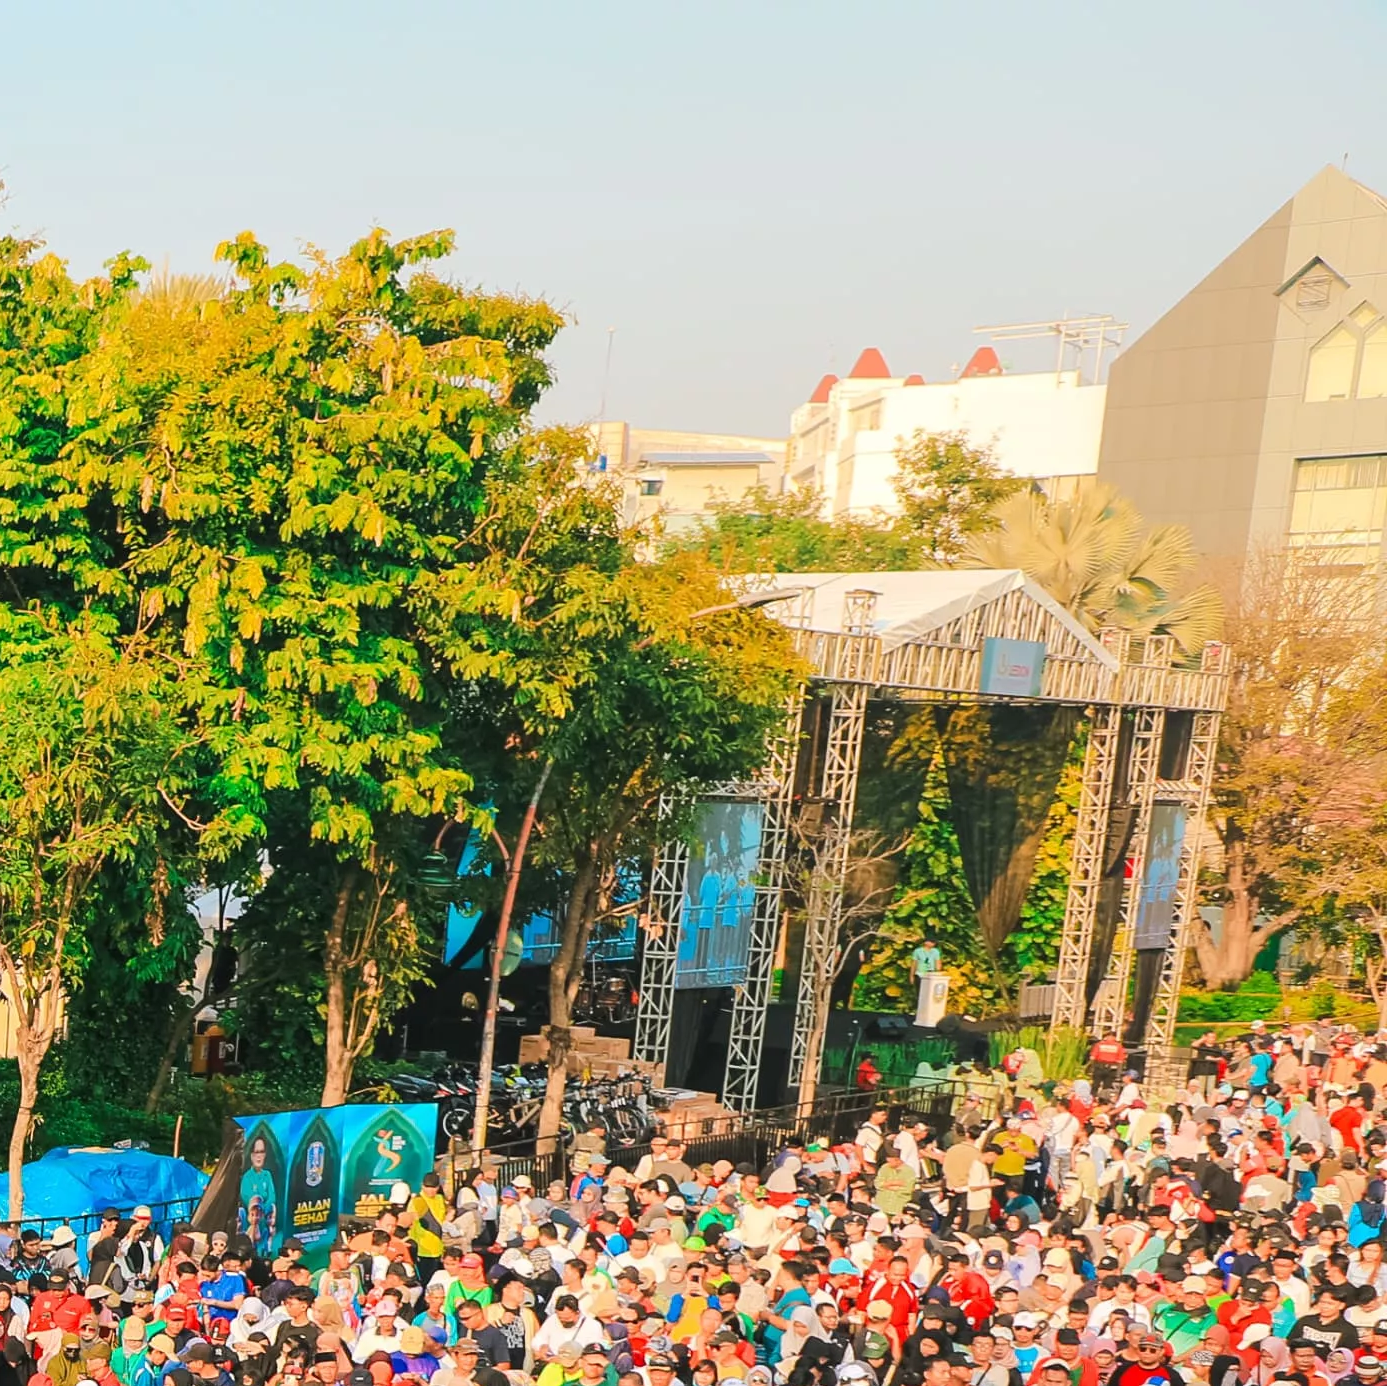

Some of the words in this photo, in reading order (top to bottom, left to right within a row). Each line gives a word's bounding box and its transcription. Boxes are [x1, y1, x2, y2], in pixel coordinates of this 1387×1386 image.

[294, 1198, 331, 1214] JALAN
[355, 1193, 392, 1206] JAL
[293, 1210, 330, 1226] SEHAT
